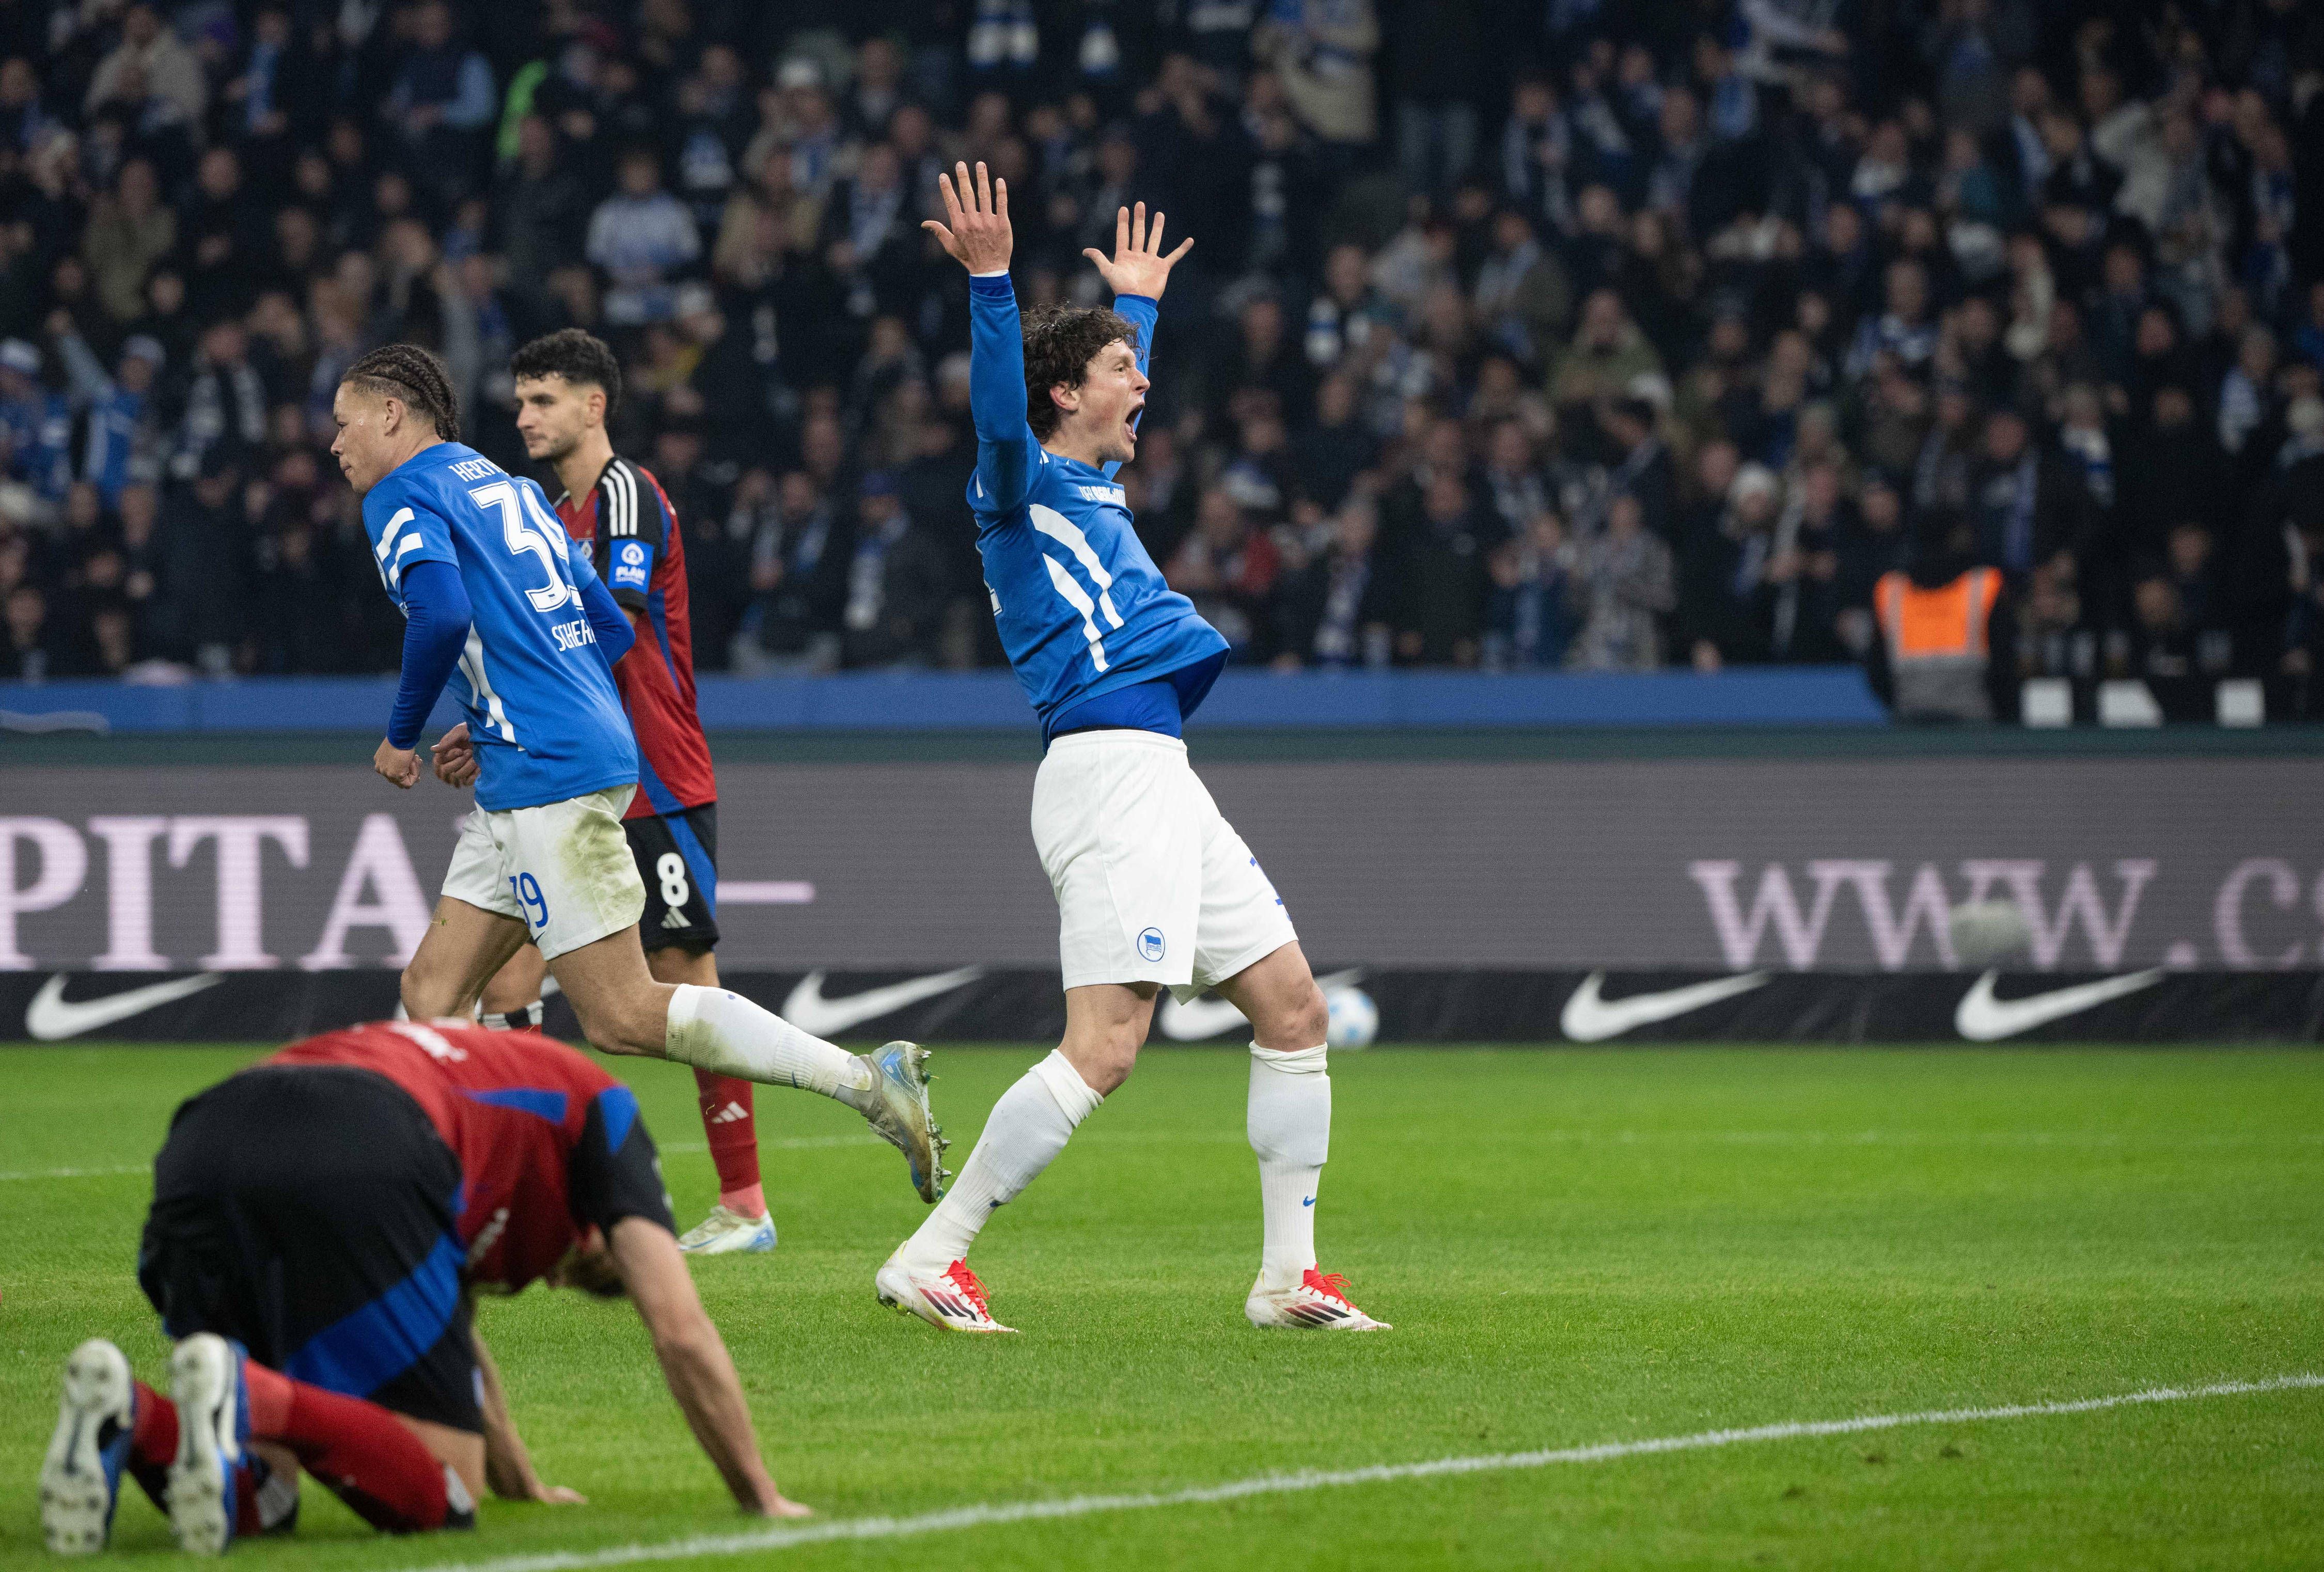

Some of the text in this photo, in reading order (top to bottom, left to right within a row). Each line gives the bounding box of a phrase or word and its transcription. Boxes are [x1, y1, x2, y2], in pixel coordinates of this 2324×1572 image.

[615, 565, 646, 581] PLAN
[0, 813, 465, 970] PITA
[657, 852, 689, 907] 8
